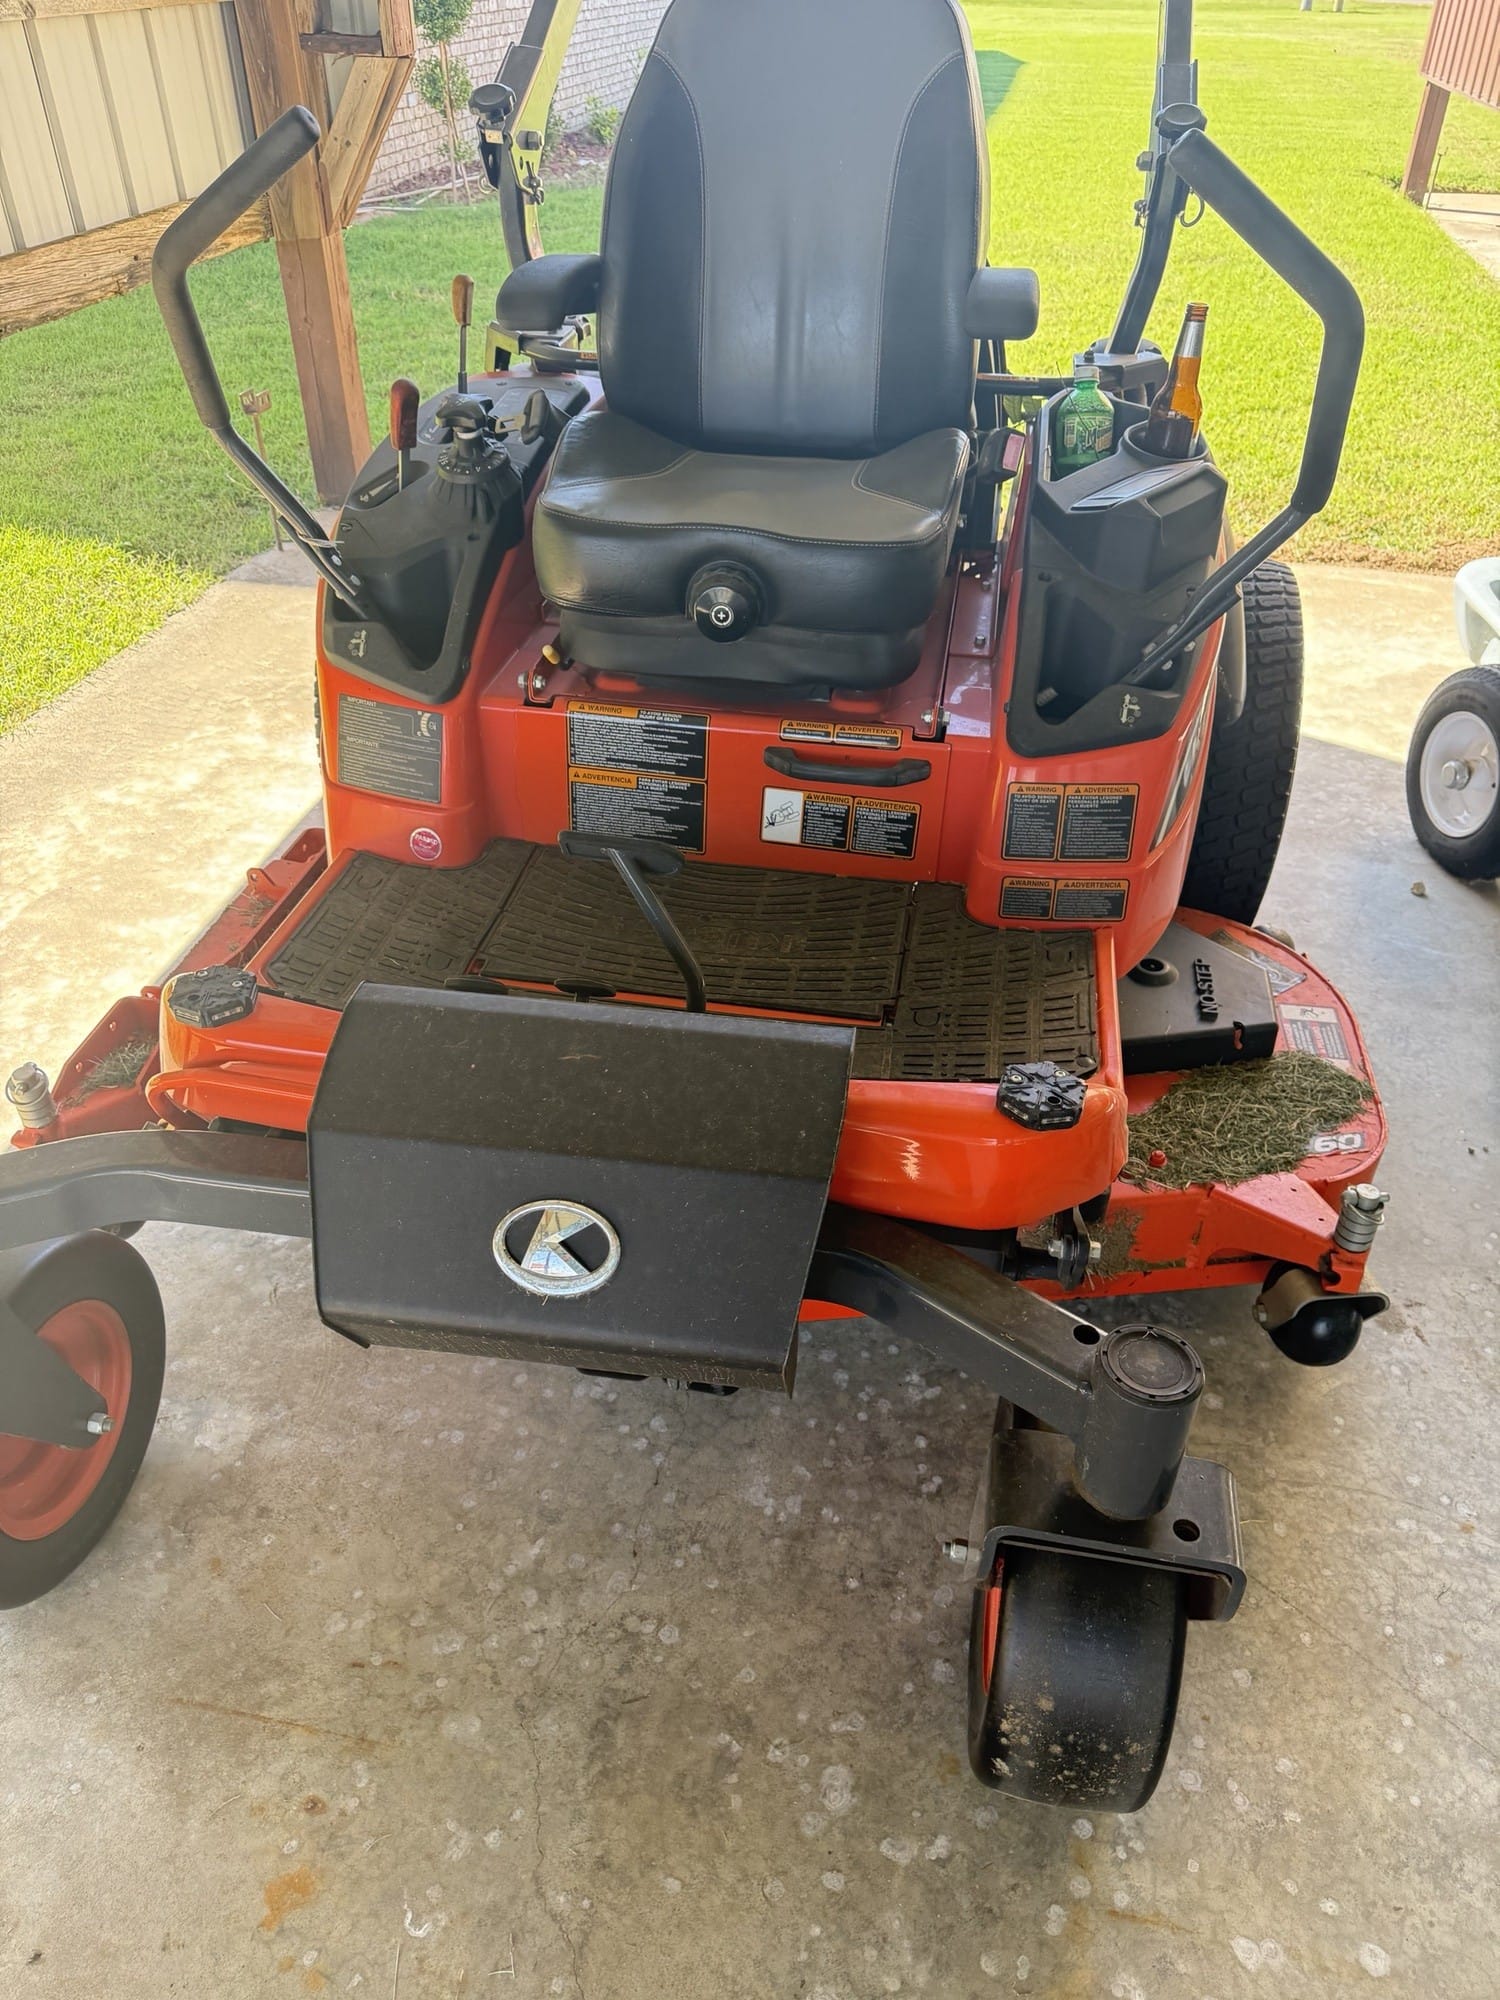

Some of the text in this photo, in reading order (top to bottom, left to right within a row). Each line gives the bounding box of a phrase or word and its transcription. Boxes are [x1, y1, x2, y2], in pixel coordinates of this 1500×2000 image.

[588, 704, 623, 714] WARNING
[796, 722, 829, 730] WARNING
[847, 726, 898, 735] ADVERTENCIA
[581, 772, 632, 784] ADVERTENCIA
[814, 795, 850, 804] WARNING
[863, 800, 917, 811] ADVERTENCIA
[1070, 881, 1122, 889] ADVERTENCIA
[1195, 958, 1218, 1014] NO STEP
[1314, 1133, 1362, 1153] 60
